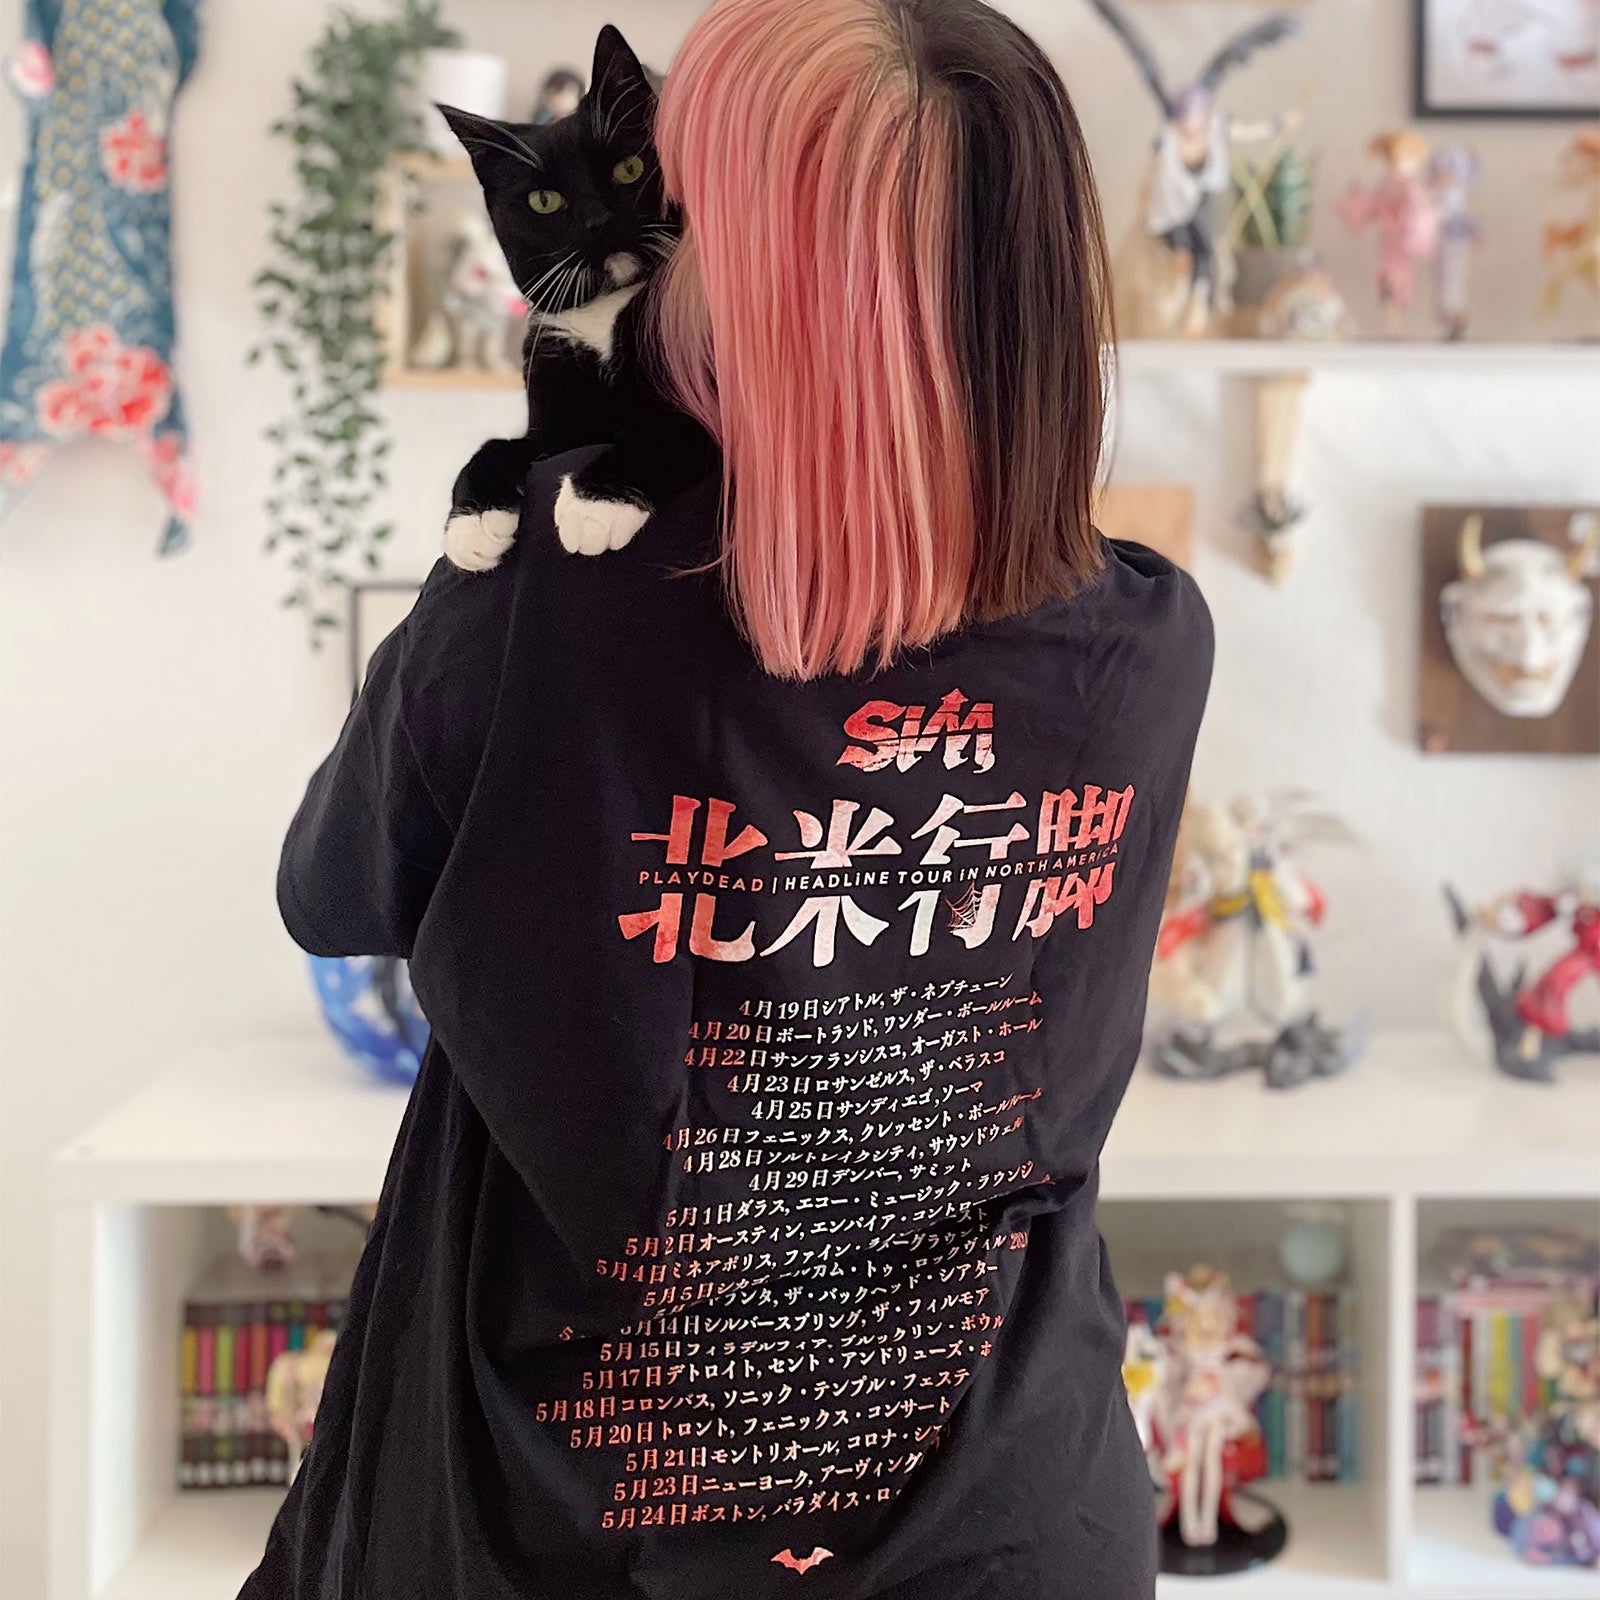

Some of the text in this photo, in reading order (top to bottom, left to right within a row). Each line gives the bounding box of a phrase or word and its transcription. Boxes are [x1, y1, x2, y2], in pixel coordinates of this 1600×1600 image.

[638, 870, 764, 892] PLAYDEAD
[898, 870, 952, 884] TOUR
[985, 859, 1048, 878] NORTH
